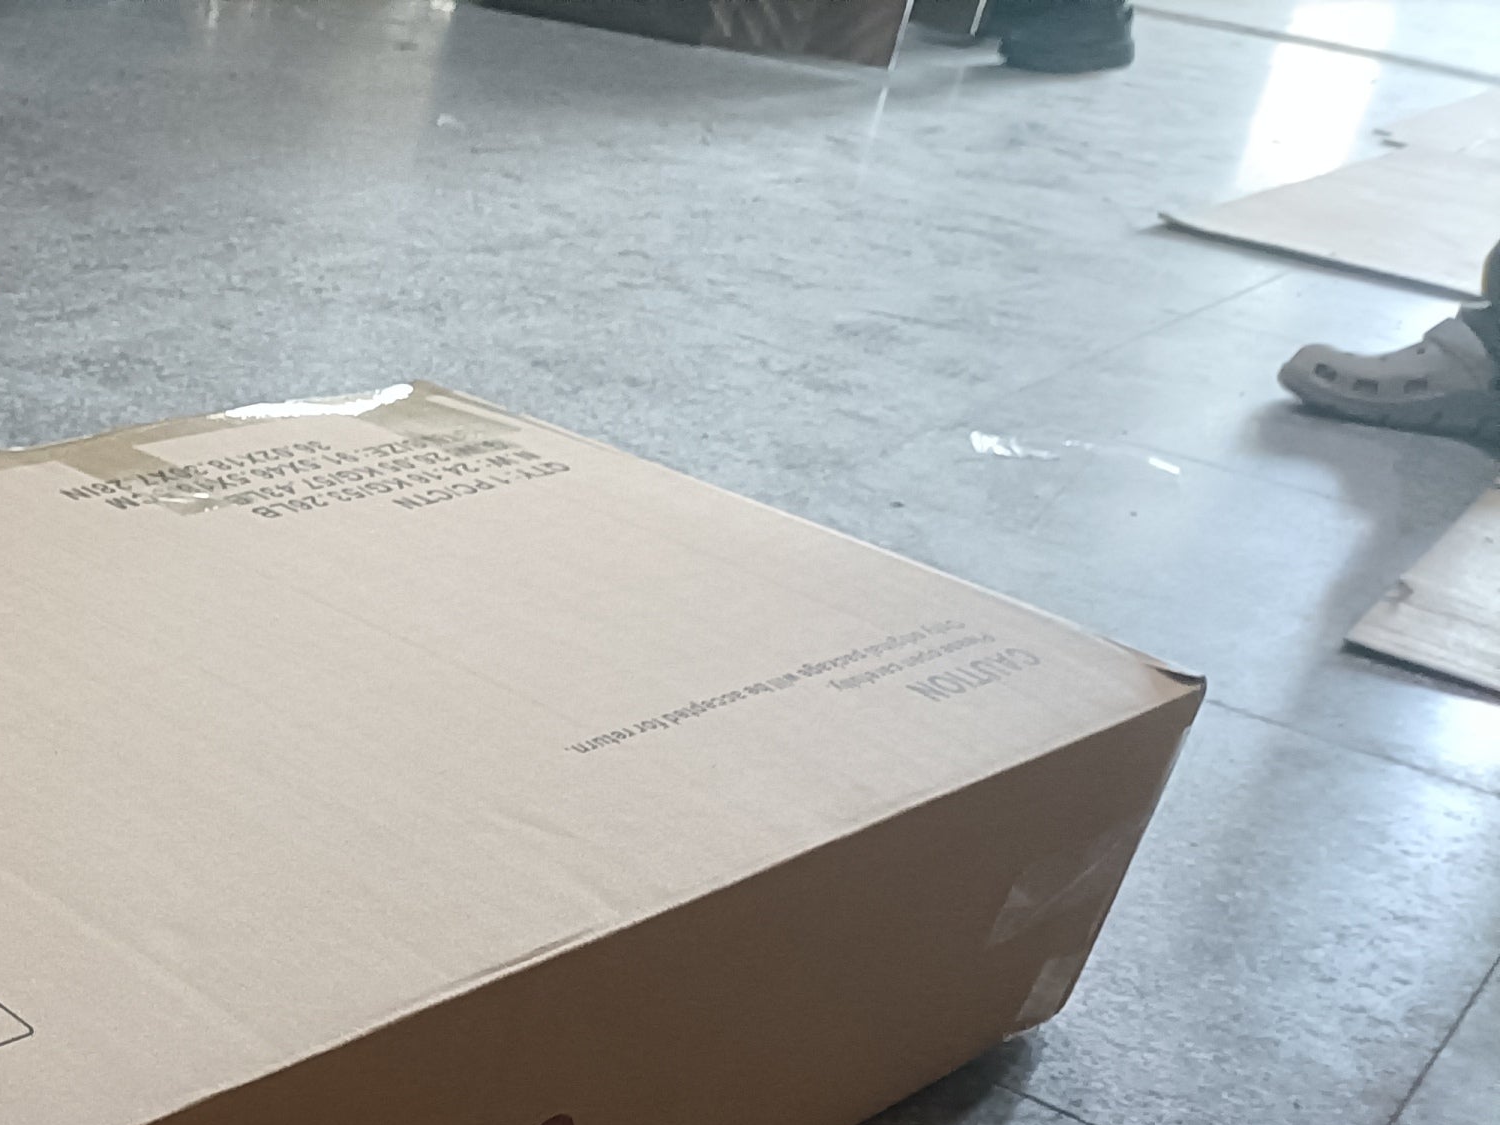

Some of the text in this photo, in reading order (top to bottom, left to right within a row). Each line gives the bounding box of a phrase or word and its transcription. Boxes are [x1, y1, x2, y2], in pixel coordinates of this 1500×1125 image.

[905, 648, 1041, 702] CAUTION
[662, 690, 747, 726] accepted
[633, 716, 669, 733] for
[564, 728, 635, 754] return.
